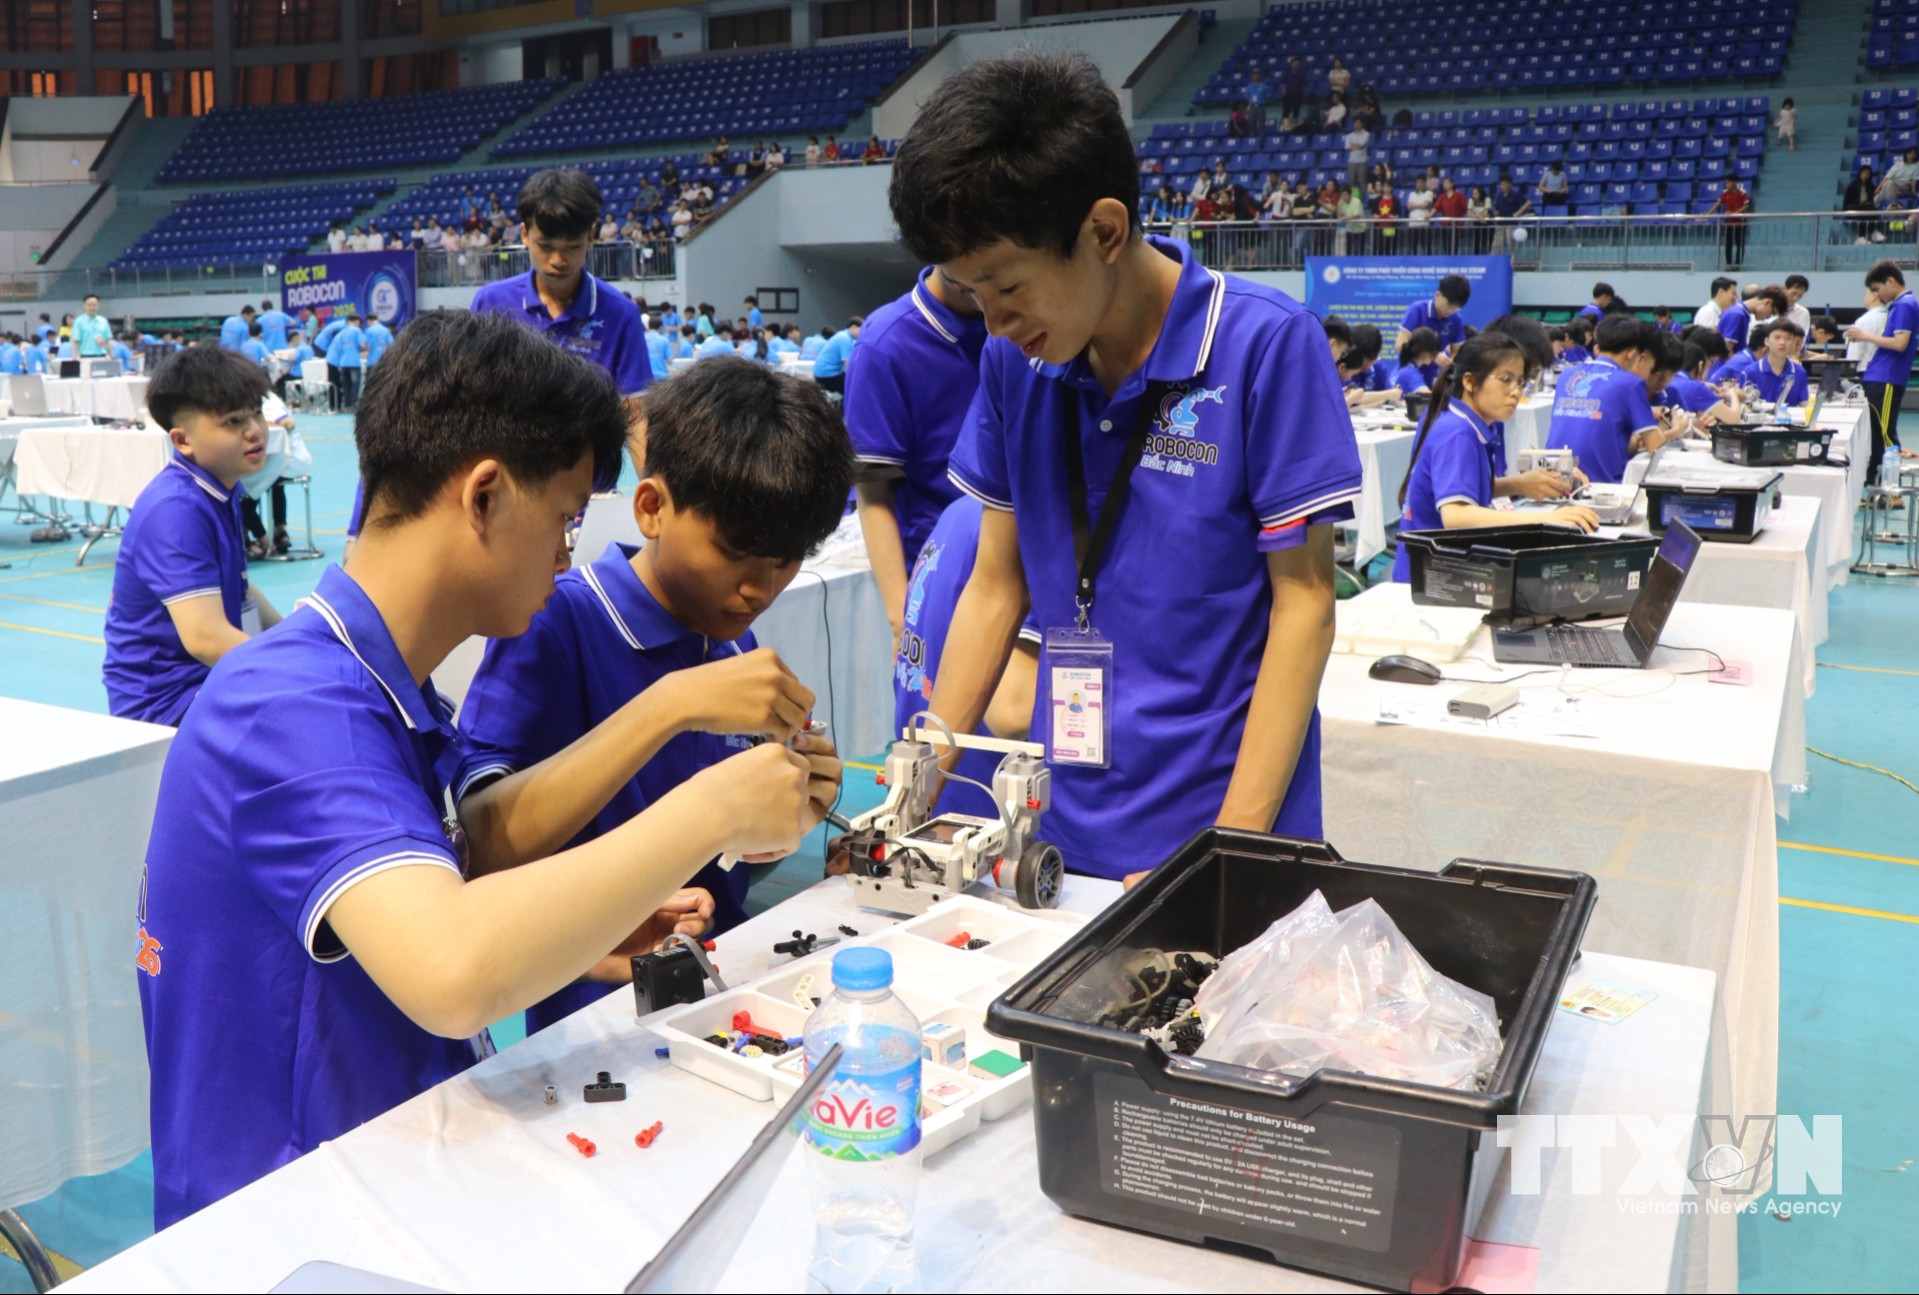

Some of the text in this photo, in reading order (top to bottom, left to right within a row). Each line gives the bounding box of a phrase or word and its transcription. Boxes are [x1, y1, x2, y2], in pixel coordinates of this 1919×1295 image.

[285, 265, 327, 285] CUỘC THI
[288, 280, 346, 307] ROBOCON
[1142, 433, 1218, 465] ROBOCON
[1140, 453, 1195, 477] Bắc Ninh
[1630, 575, 1638, 585] 12
[1121, 1108, 1161, 1122] Rechargeable
[1162, 1116, 1187, 1126] batteries
[1188, 1122, 1208, 1131] should
[1170, 1098, 1315, 1135] Precautions for Battery Usage
[1134, 1119, 1151, 1128] power
[1185, 1128, 1198, 1136] must
[1200, 1131, 1209, 1139] not
[1226, 1122, 1246, 1133] battery
[1120, 1156, 1139, 1166] Please
[1133, 1138, 1155, 1149] product
[1162, 1144, 1203, 1158] recommended
[1342, 1181, 1354, 1189] and
[1356, 1184, 1372, 1192] other
[1288, 1156, 1316, 1167] charging
[1317, 1161, 1351, 1173] connection
[1353, 1168, 1373, 1177] before
[1134, 1187, 1156, 1198] product
[1157, 1192, 1176, 1201] should
